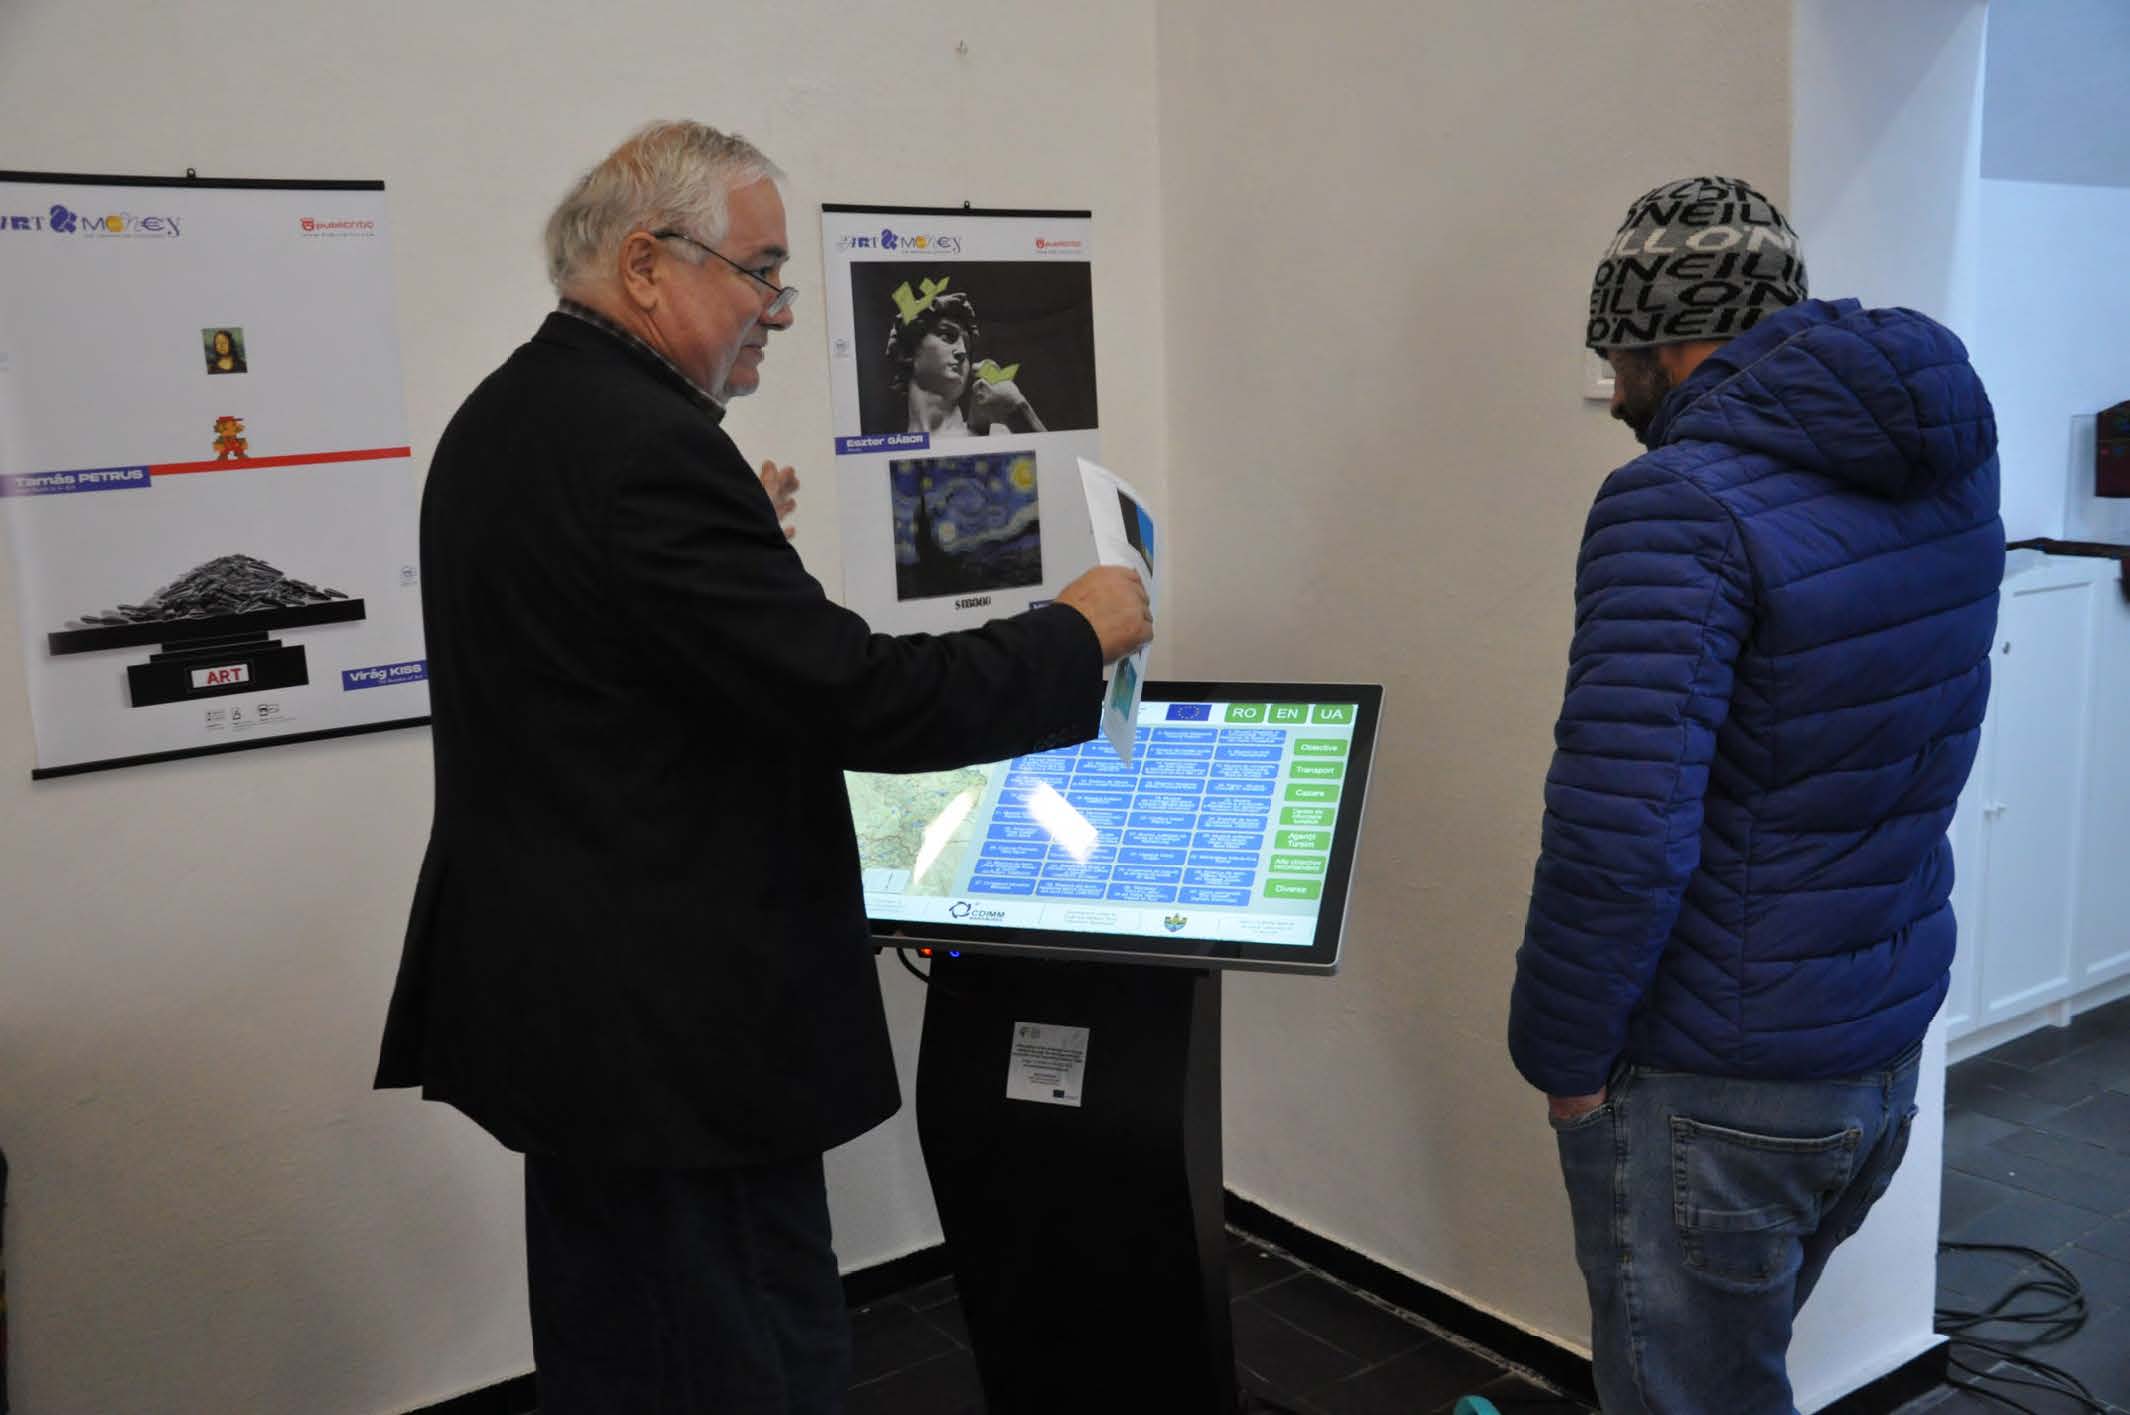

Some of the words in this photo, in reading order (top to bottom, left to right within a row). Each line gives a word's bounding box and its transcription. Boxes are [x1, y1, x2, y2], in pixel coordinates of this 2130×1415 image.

[78, 469, 145, 483] PETRUS
[207, 667, 242, 684] ART
[349, 668, 387, 681] Virág
[389, 664, 423, 677] KISS
[1231, 707, 1257, 719] RO
[1276, 708, 1299, 719] EN
[1320, 708, 1344, 719] UA
[1296, 766, 1336, 775] Transport
